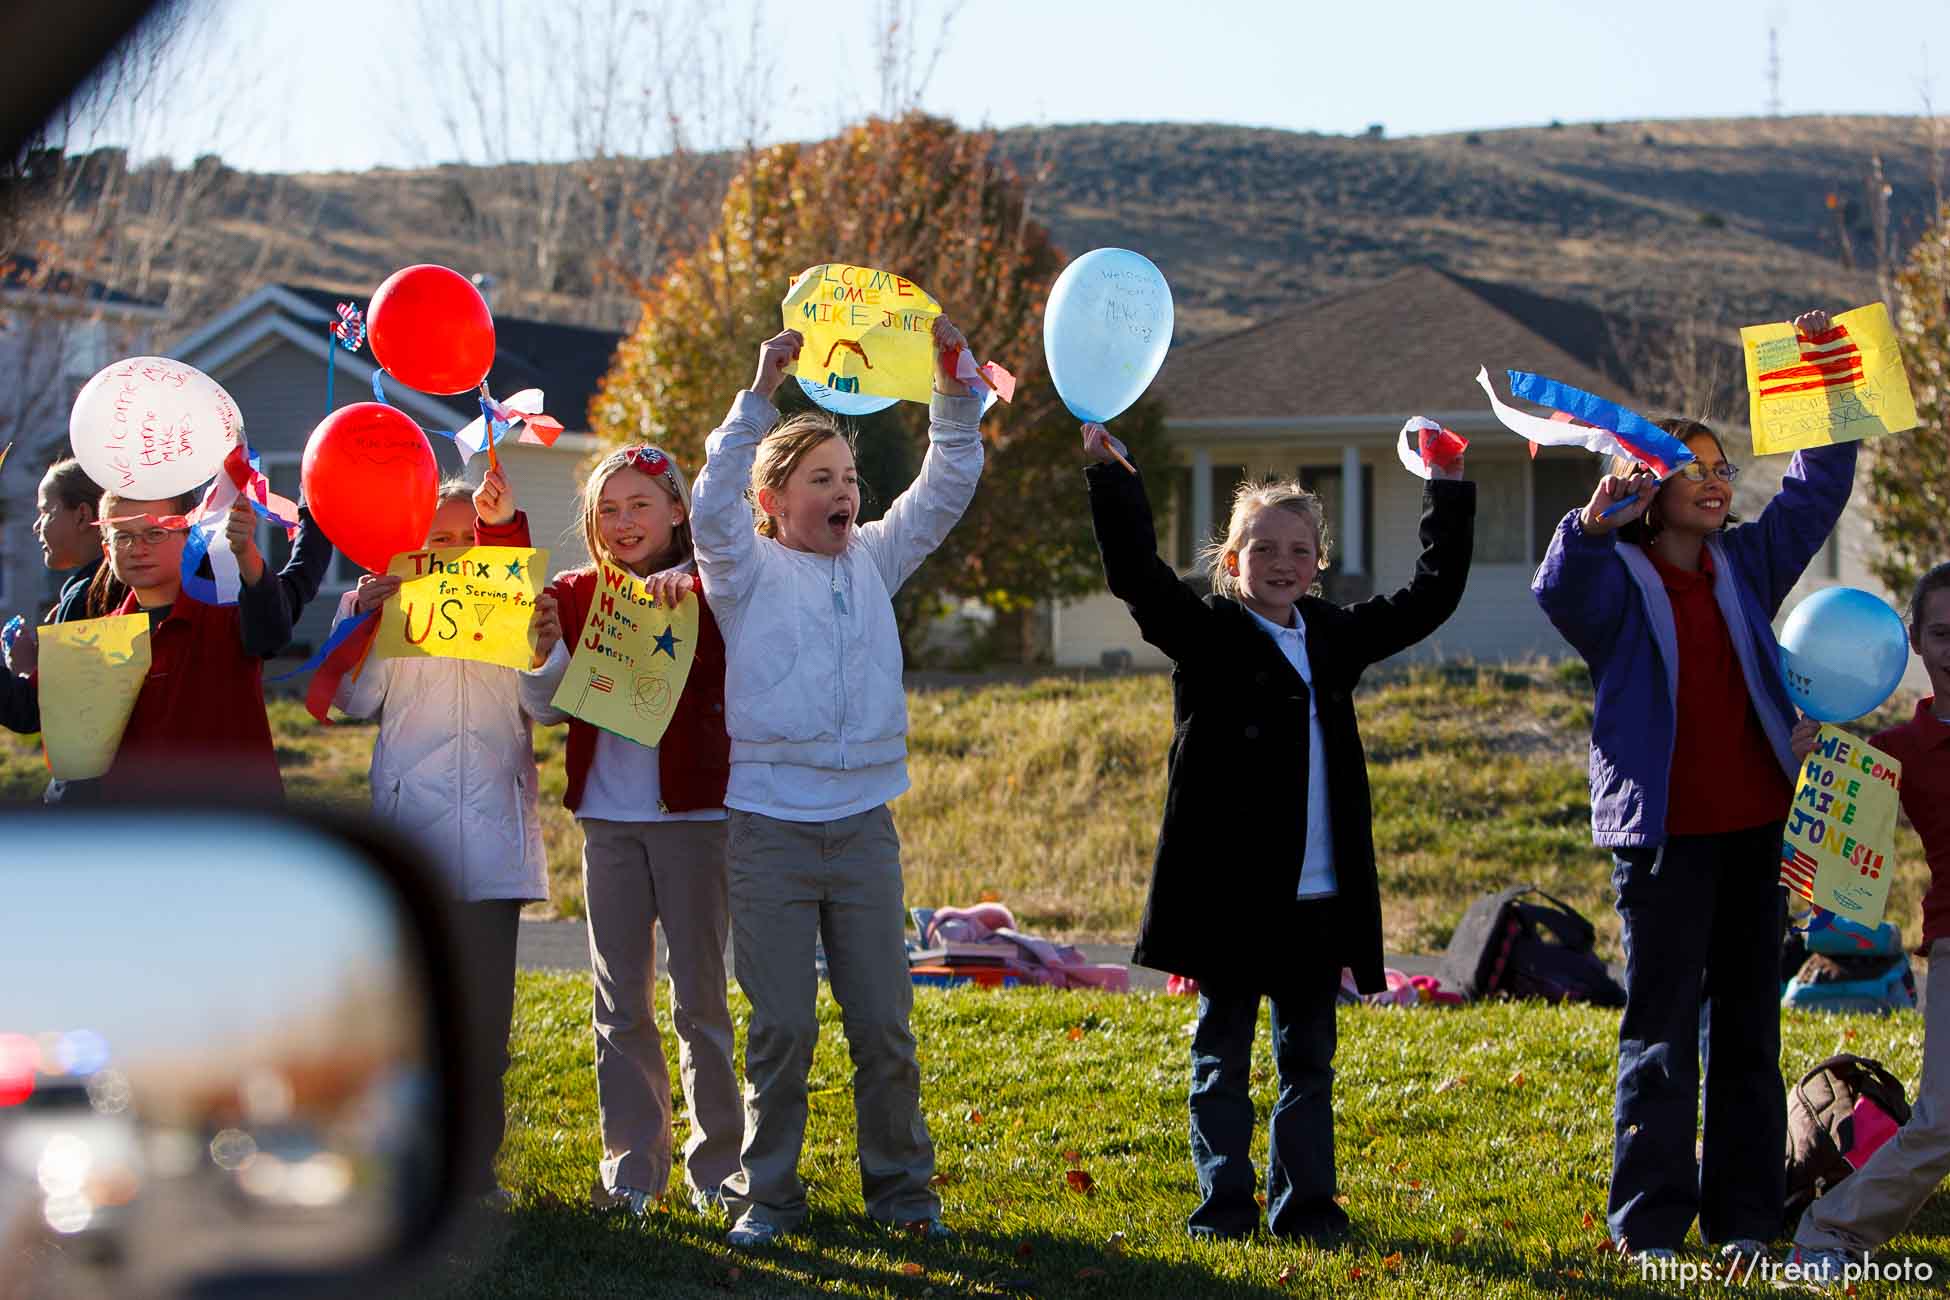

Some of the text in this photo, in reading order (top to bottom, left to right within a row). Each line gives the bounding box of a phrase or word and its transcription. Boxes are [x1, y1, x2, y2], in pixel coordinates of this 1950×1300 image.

[815, 265, 914, 296] LCOME
[821, 284, 880, 304] HOME
[803, 302, 871, 327] MIKE
[408, 553, 490, 579] Thanx
[440, 580, 459, 596] for
[590, 612, 623, 641] Mike
[600, 592, 640, 633] Home
[1806, 760, 1861, 798] HOME
[1797, 783, 1857, 825] MIKE
[1788, 807, 1884, 880] JONES!!
